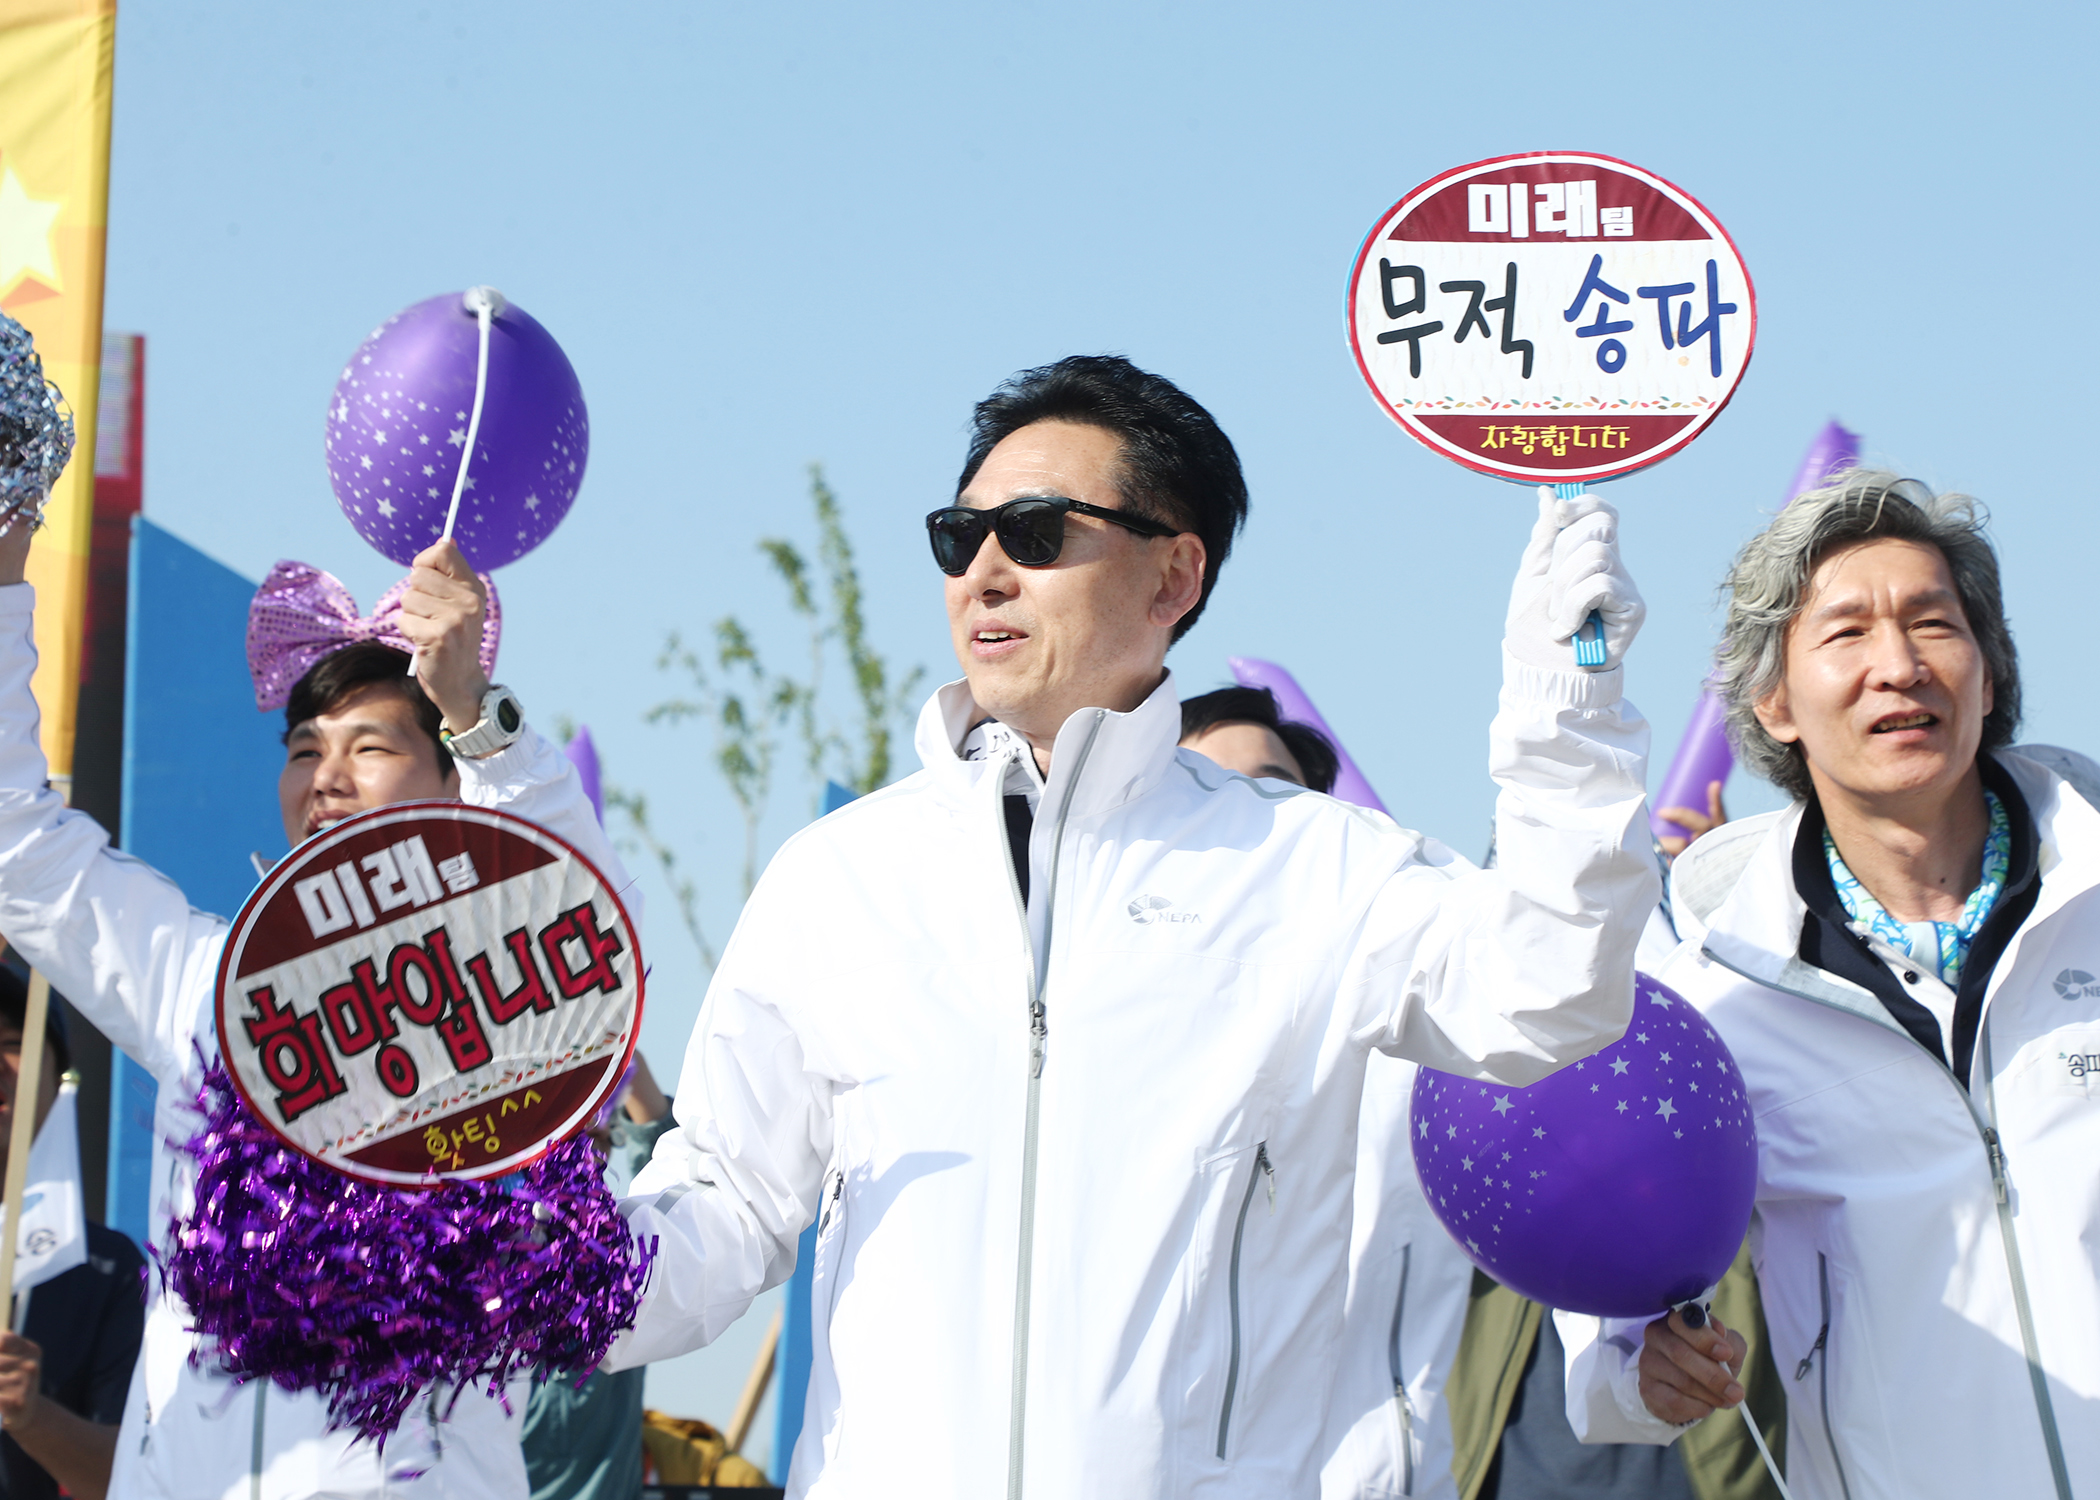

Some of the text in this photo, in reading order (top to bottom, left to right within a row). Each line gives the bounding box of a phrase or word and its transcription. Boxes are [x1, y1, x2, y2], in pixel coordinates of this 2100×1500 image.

[1467, 179, 1634, 239] 미래팀
[1376, 253, 1738, 379] 무적 송파
[1478, 424, 1631, 457] 사랑합니다
[1157, 911, 1203, 924] NEPA
[240, 900, 626, 1125] 희망입니다
